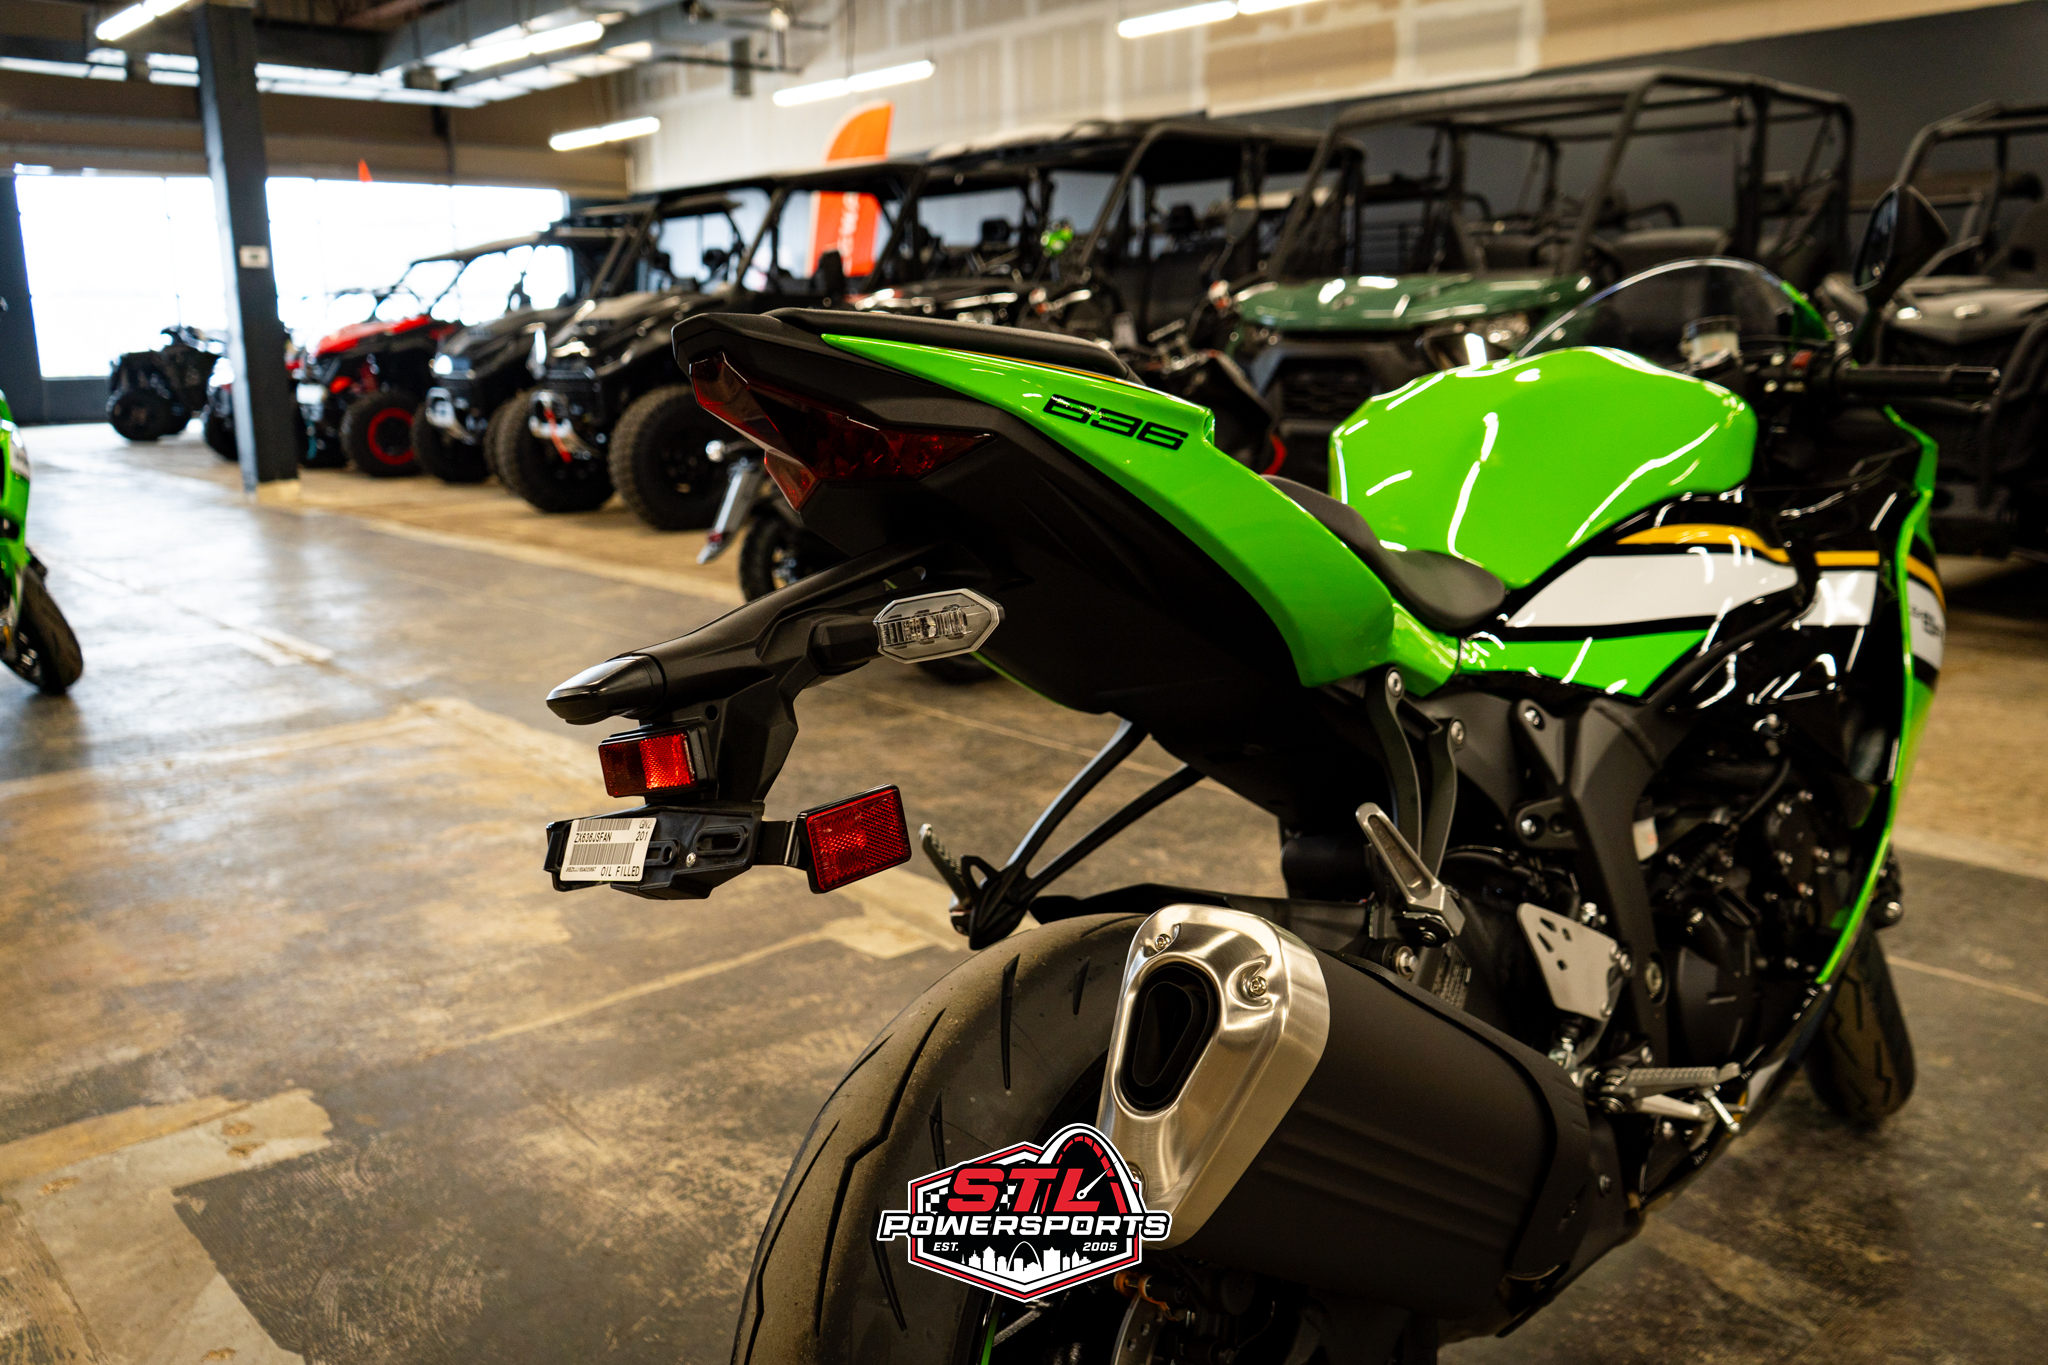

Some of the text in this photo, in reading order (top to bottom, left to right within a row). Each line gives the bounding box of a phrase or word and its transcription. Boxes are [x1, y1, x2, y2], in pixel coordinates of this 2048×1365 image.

[1043, 393, 1189, 451] 636
[635, 830, 649, 841] 201
[600, 866, 612, 877] OIL
[615, 866, 640, 877] FILLED
